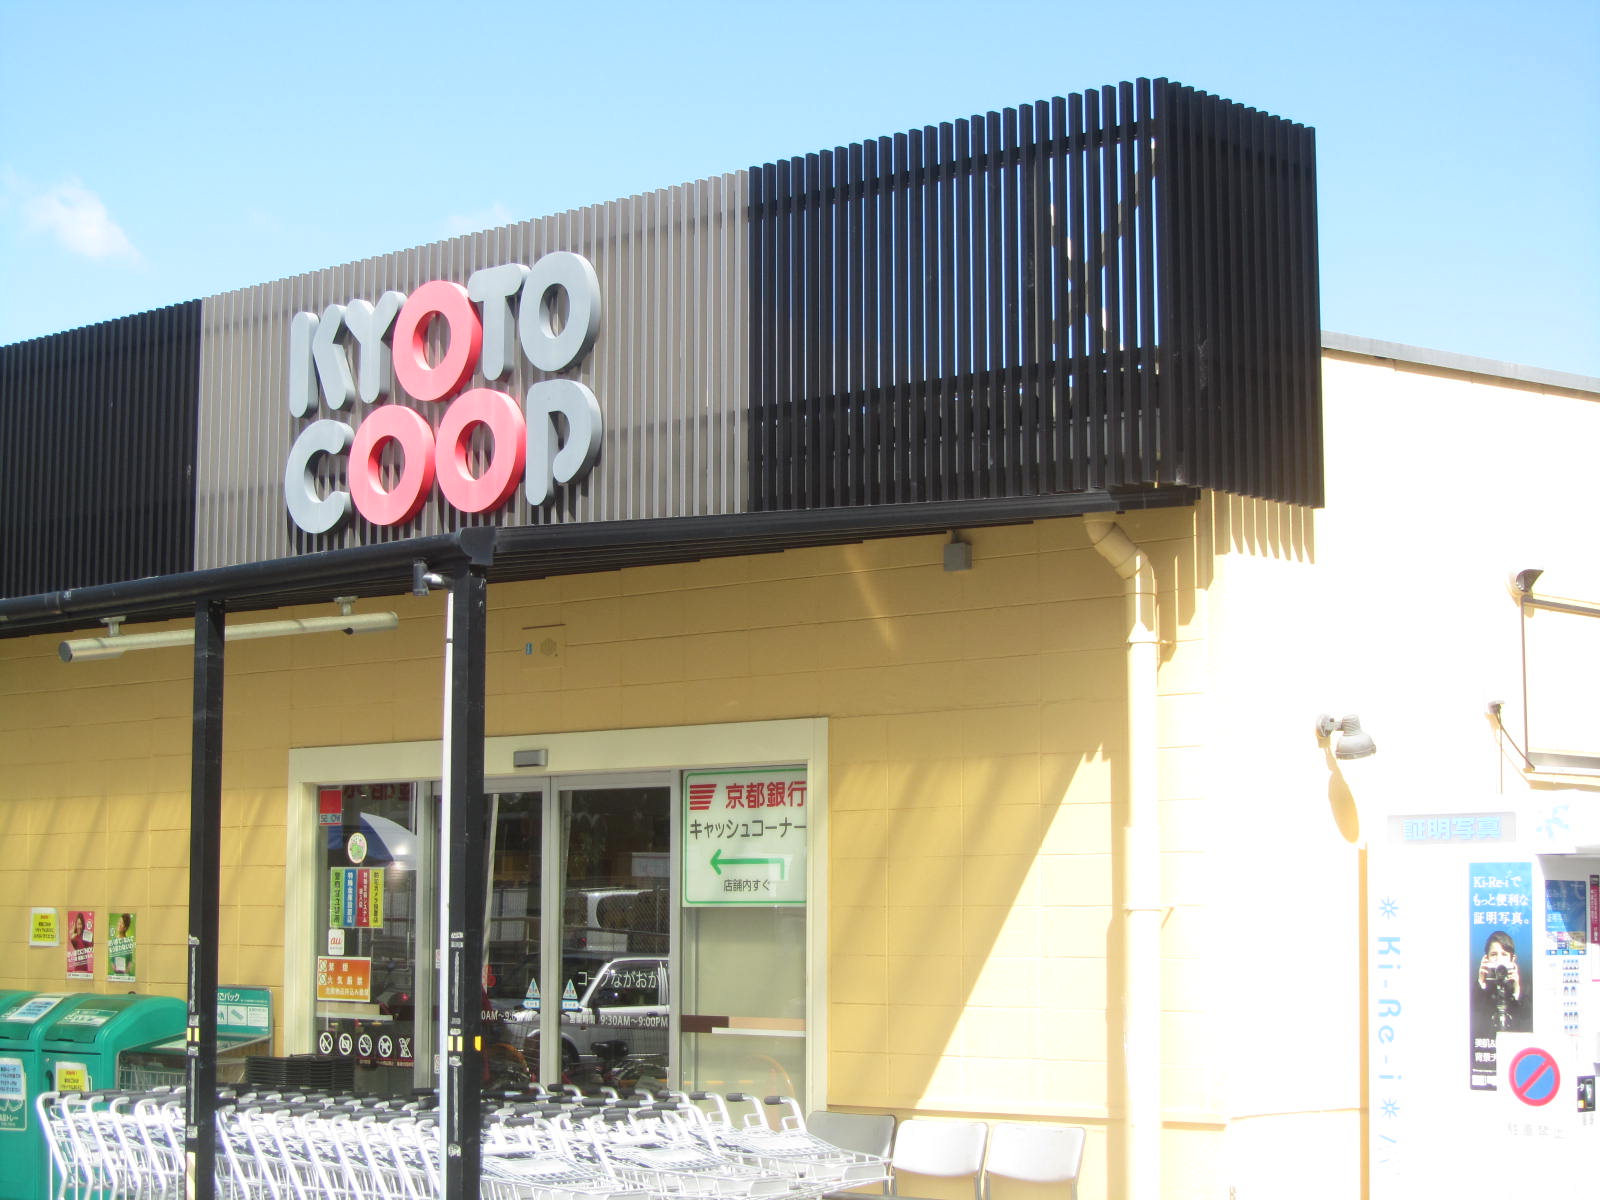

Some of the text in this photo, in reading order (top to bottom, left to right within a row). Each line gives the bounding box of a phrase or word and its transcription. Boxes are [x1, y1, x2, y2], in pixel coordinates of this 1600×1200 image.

[290, 251, 600, 418] KYOTO
[285, 379, 602, 533] COOP
[725, 781, 807, 809] 京都銀行
[690, 817, 807, 840] キャッシュコーナー
[1402, 816, 1503, 841] 証明写真
[723, 879, 770, 892] 店舗内すぐ
[1473, 893, 1529, 907] もっと便利な
[1377, 936, 1403, 1080] Ki-Re-i
